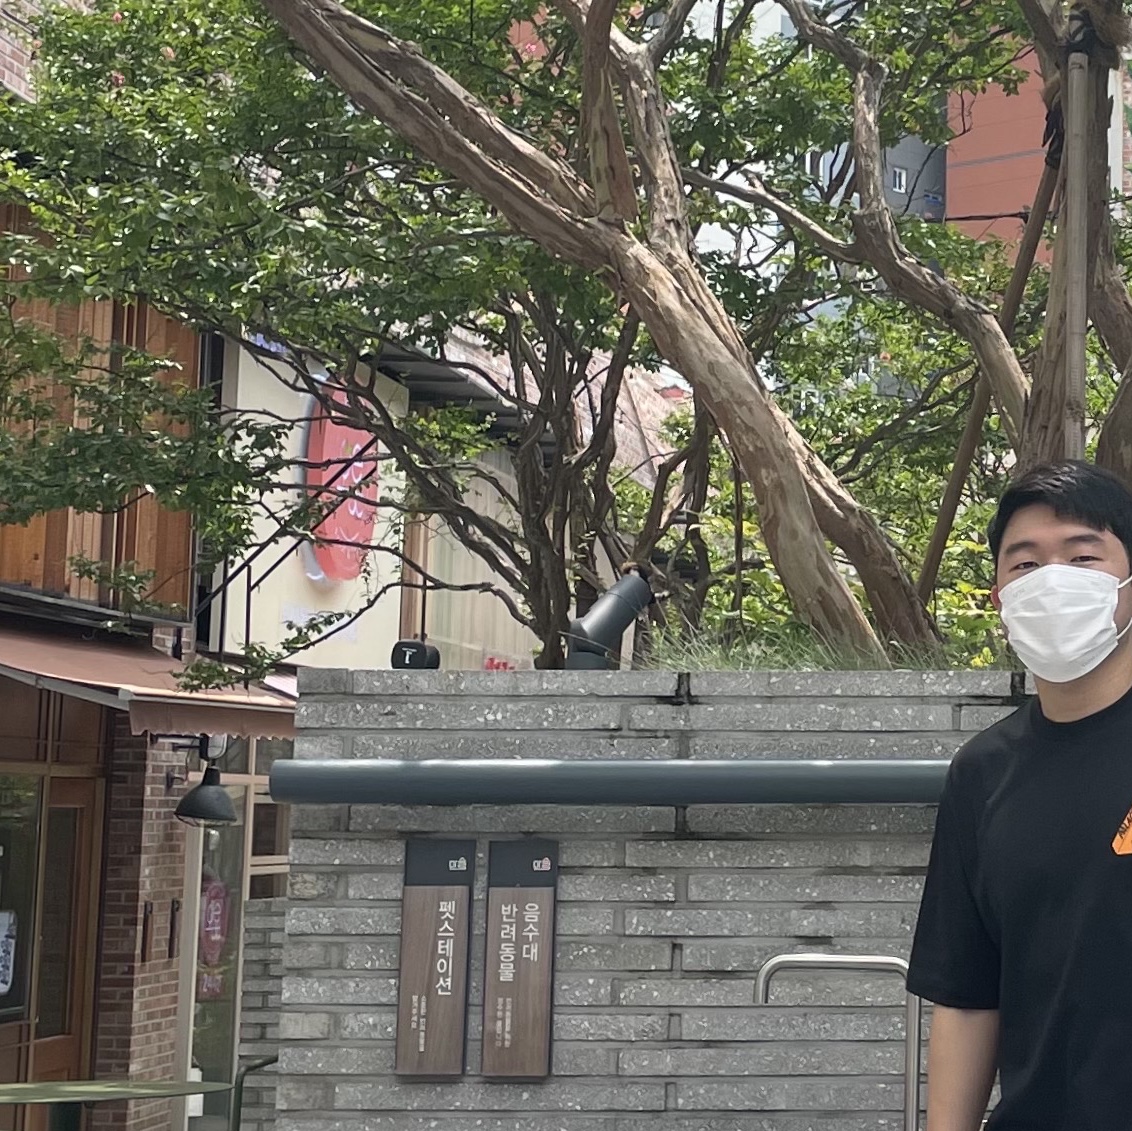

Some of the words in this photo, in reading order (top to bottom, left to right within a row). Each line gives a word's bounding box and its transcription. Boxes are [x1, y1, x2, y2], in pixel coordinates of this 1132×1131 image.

[435, 901, 456, 996] 펫스테이션
[498, 903, 518, 982] 반려동물
[522, 902, 541, 962] 음수대
